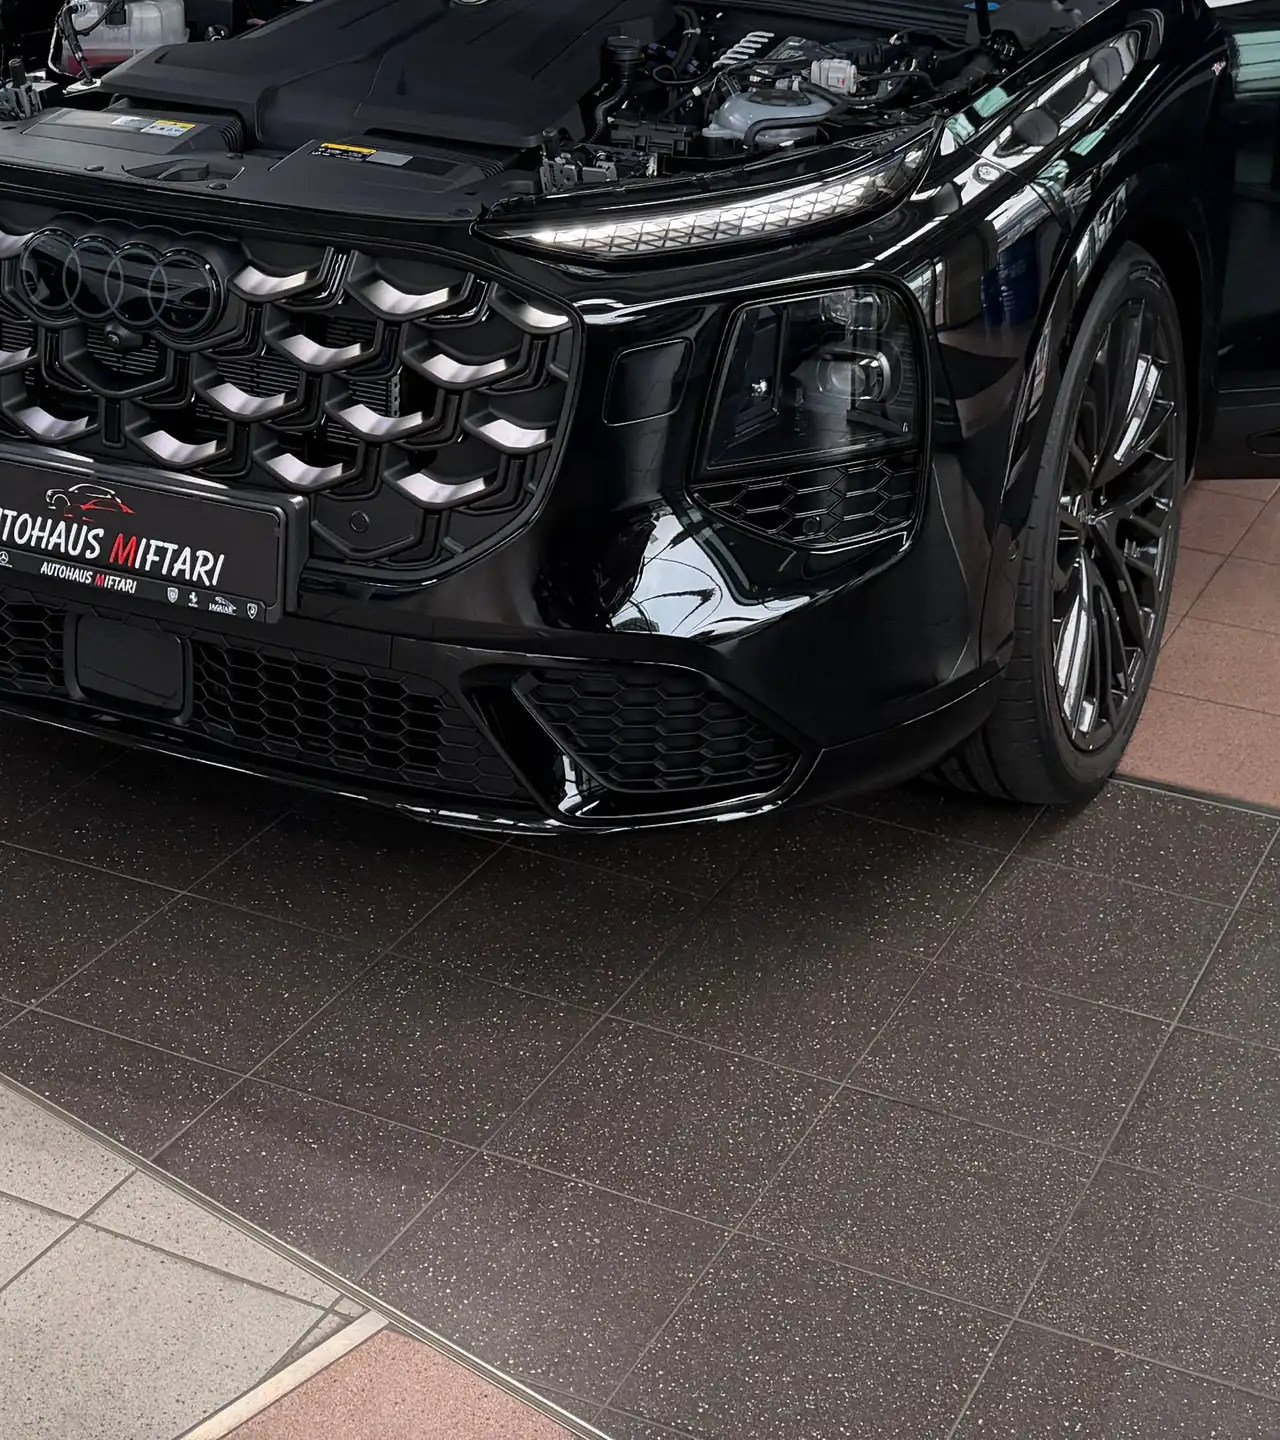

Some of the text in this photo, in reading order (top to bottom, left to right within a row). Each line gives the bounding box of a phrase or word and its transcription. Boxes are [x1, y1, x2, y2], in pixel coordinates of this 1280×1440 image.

[40, 561, 137, 594] AUTOHAUS MIFTARI
[108, 532, 225, 586] MIFTARI
